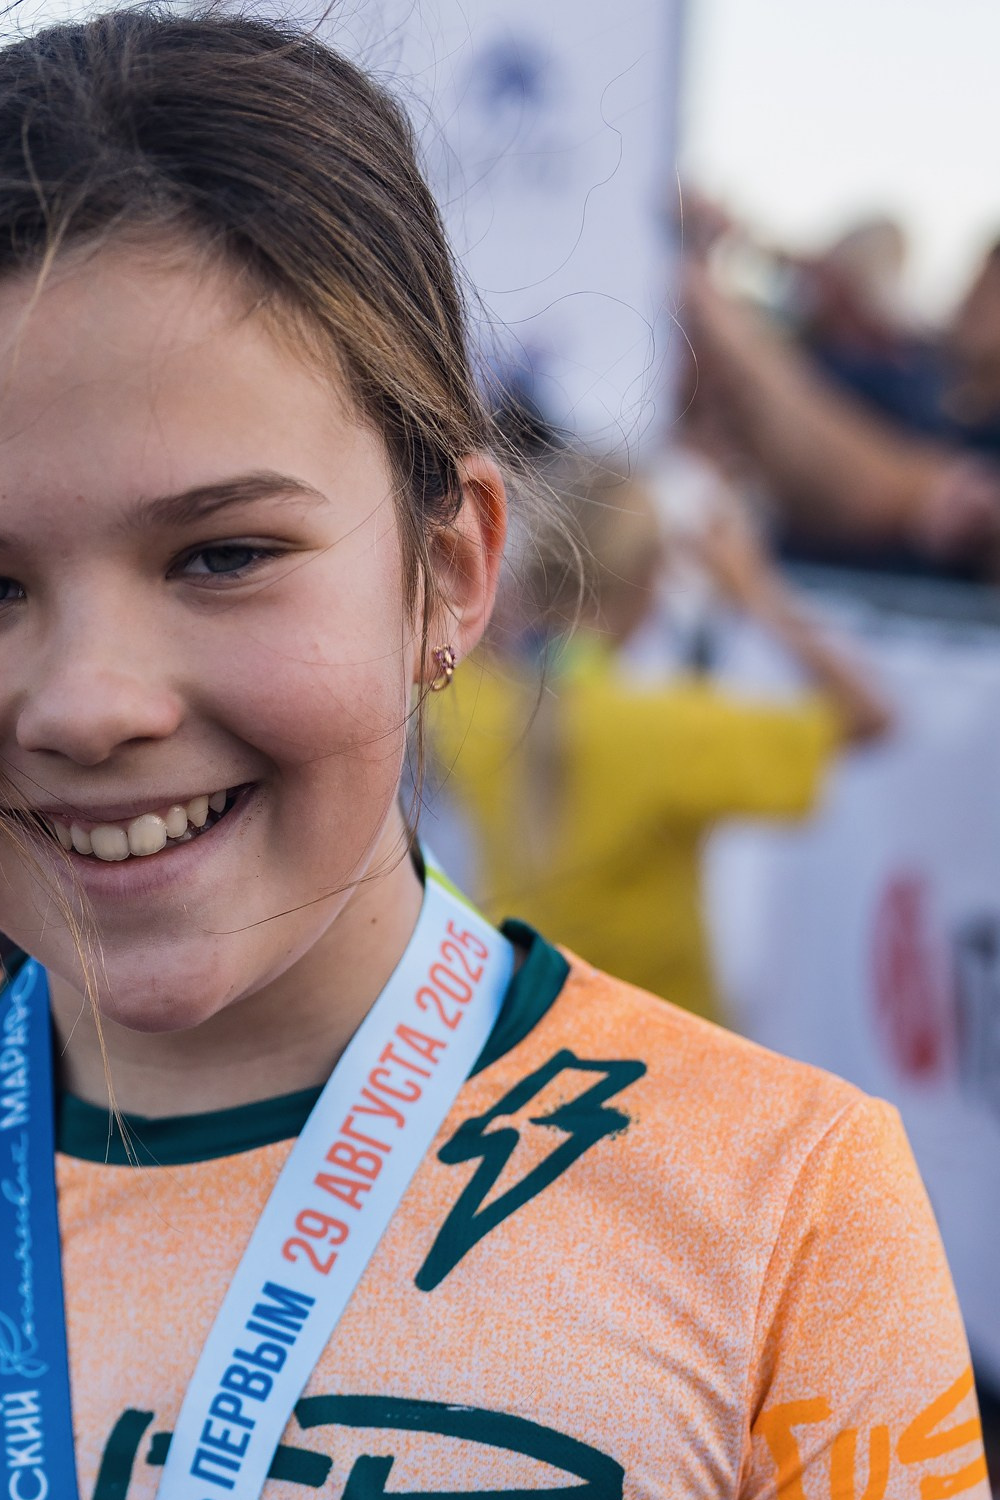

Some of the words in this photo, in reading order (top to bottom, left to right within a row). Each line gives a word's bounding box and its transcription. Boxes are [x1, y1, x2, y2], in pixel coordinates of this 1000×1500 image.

[415, 920, 490, 1031] 2025
[313, 1022, 447, 1211] АВГУСТА
[281, 1208, 350, 1276] 29
[190, 1281, 317, 1489] ПЕРВЫМ
